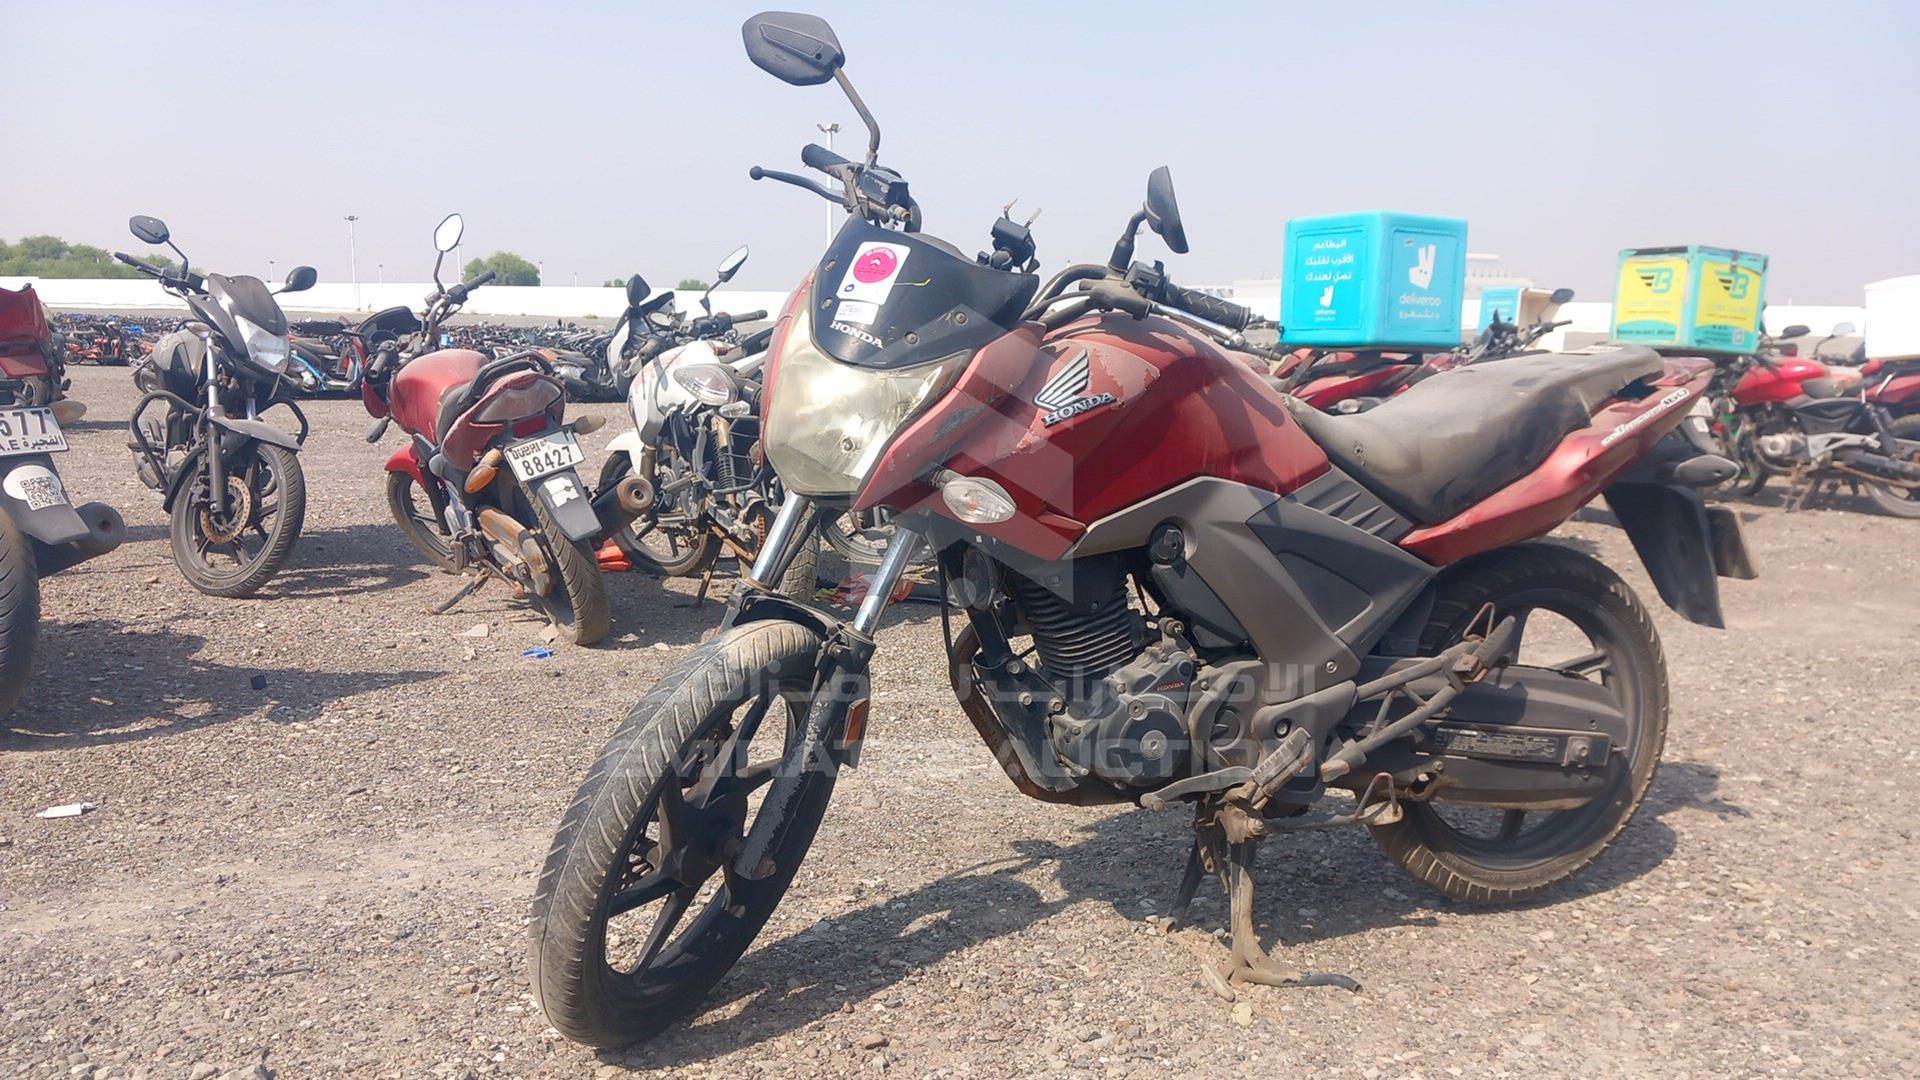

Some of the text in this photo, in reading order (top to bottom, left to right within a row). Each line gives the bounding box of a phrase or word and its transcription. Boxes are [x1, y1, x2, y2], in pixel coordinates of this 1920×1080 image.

[1400, 293, 1441, 306] deliveroo
[830, 320, 884, 349] HONDA
[1042, 392, 1116, 428] HONDA
[23, 436, 64, 450] الفجيرة
[522, 446, 572, 476] 88427
[1156, 681, 1185, 691] HONDA
